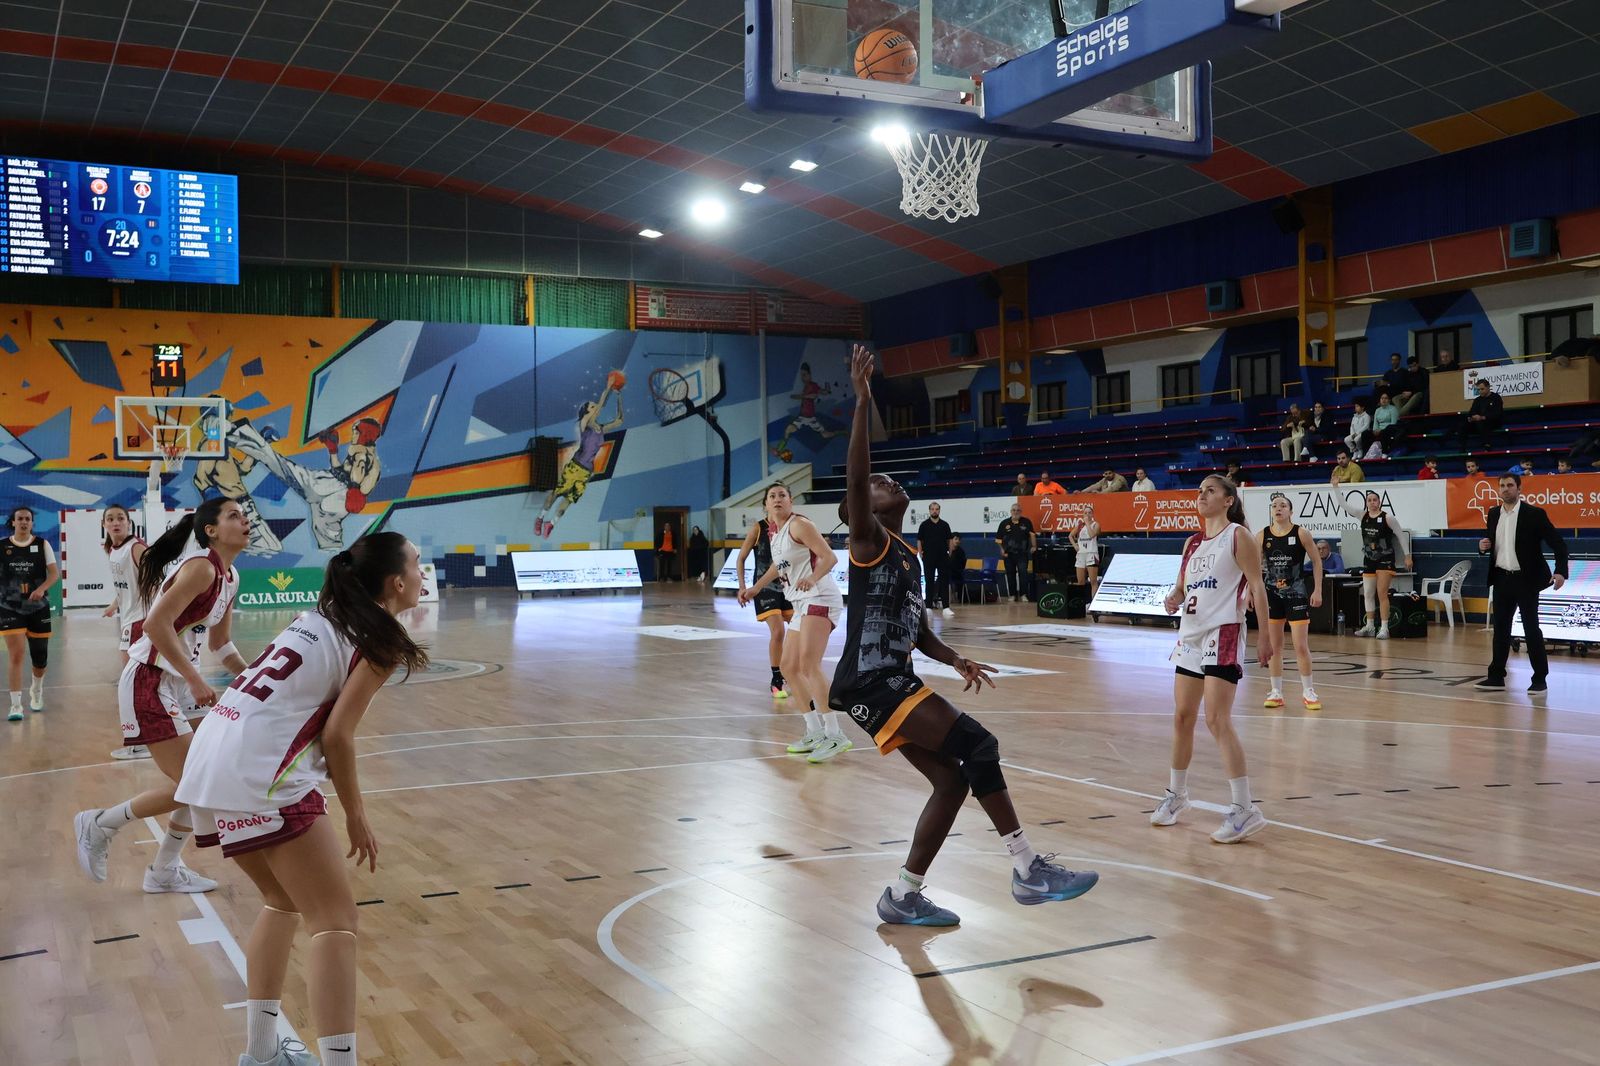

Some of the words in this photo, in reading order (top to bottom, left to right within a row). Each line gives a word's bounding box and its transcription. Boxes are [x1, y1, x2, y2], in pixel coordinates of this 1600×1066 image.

[1057, 15, 1129, 59] Schelde
[1057, 33, 1130, 78] Sports
[91, 197, 106, 211] 17
[137, 200, 146, 214] 7
[106, 230, 140, 249] 7:24
[85, 250, 93, 263] 0
[150, 254, 157, 266] 3
[158, 345, 181, 355] 7:24
[157, 361, 178, 377] 11
[1496, 382, 1540, 394] ZAMORA
[1519, 488, 1584, 505] ecoletas
[1153, 516, 1202, 530] ZAMORA
[239, 592, 275, 605] CAJA
[1186, 596, 1198, 615] 2
